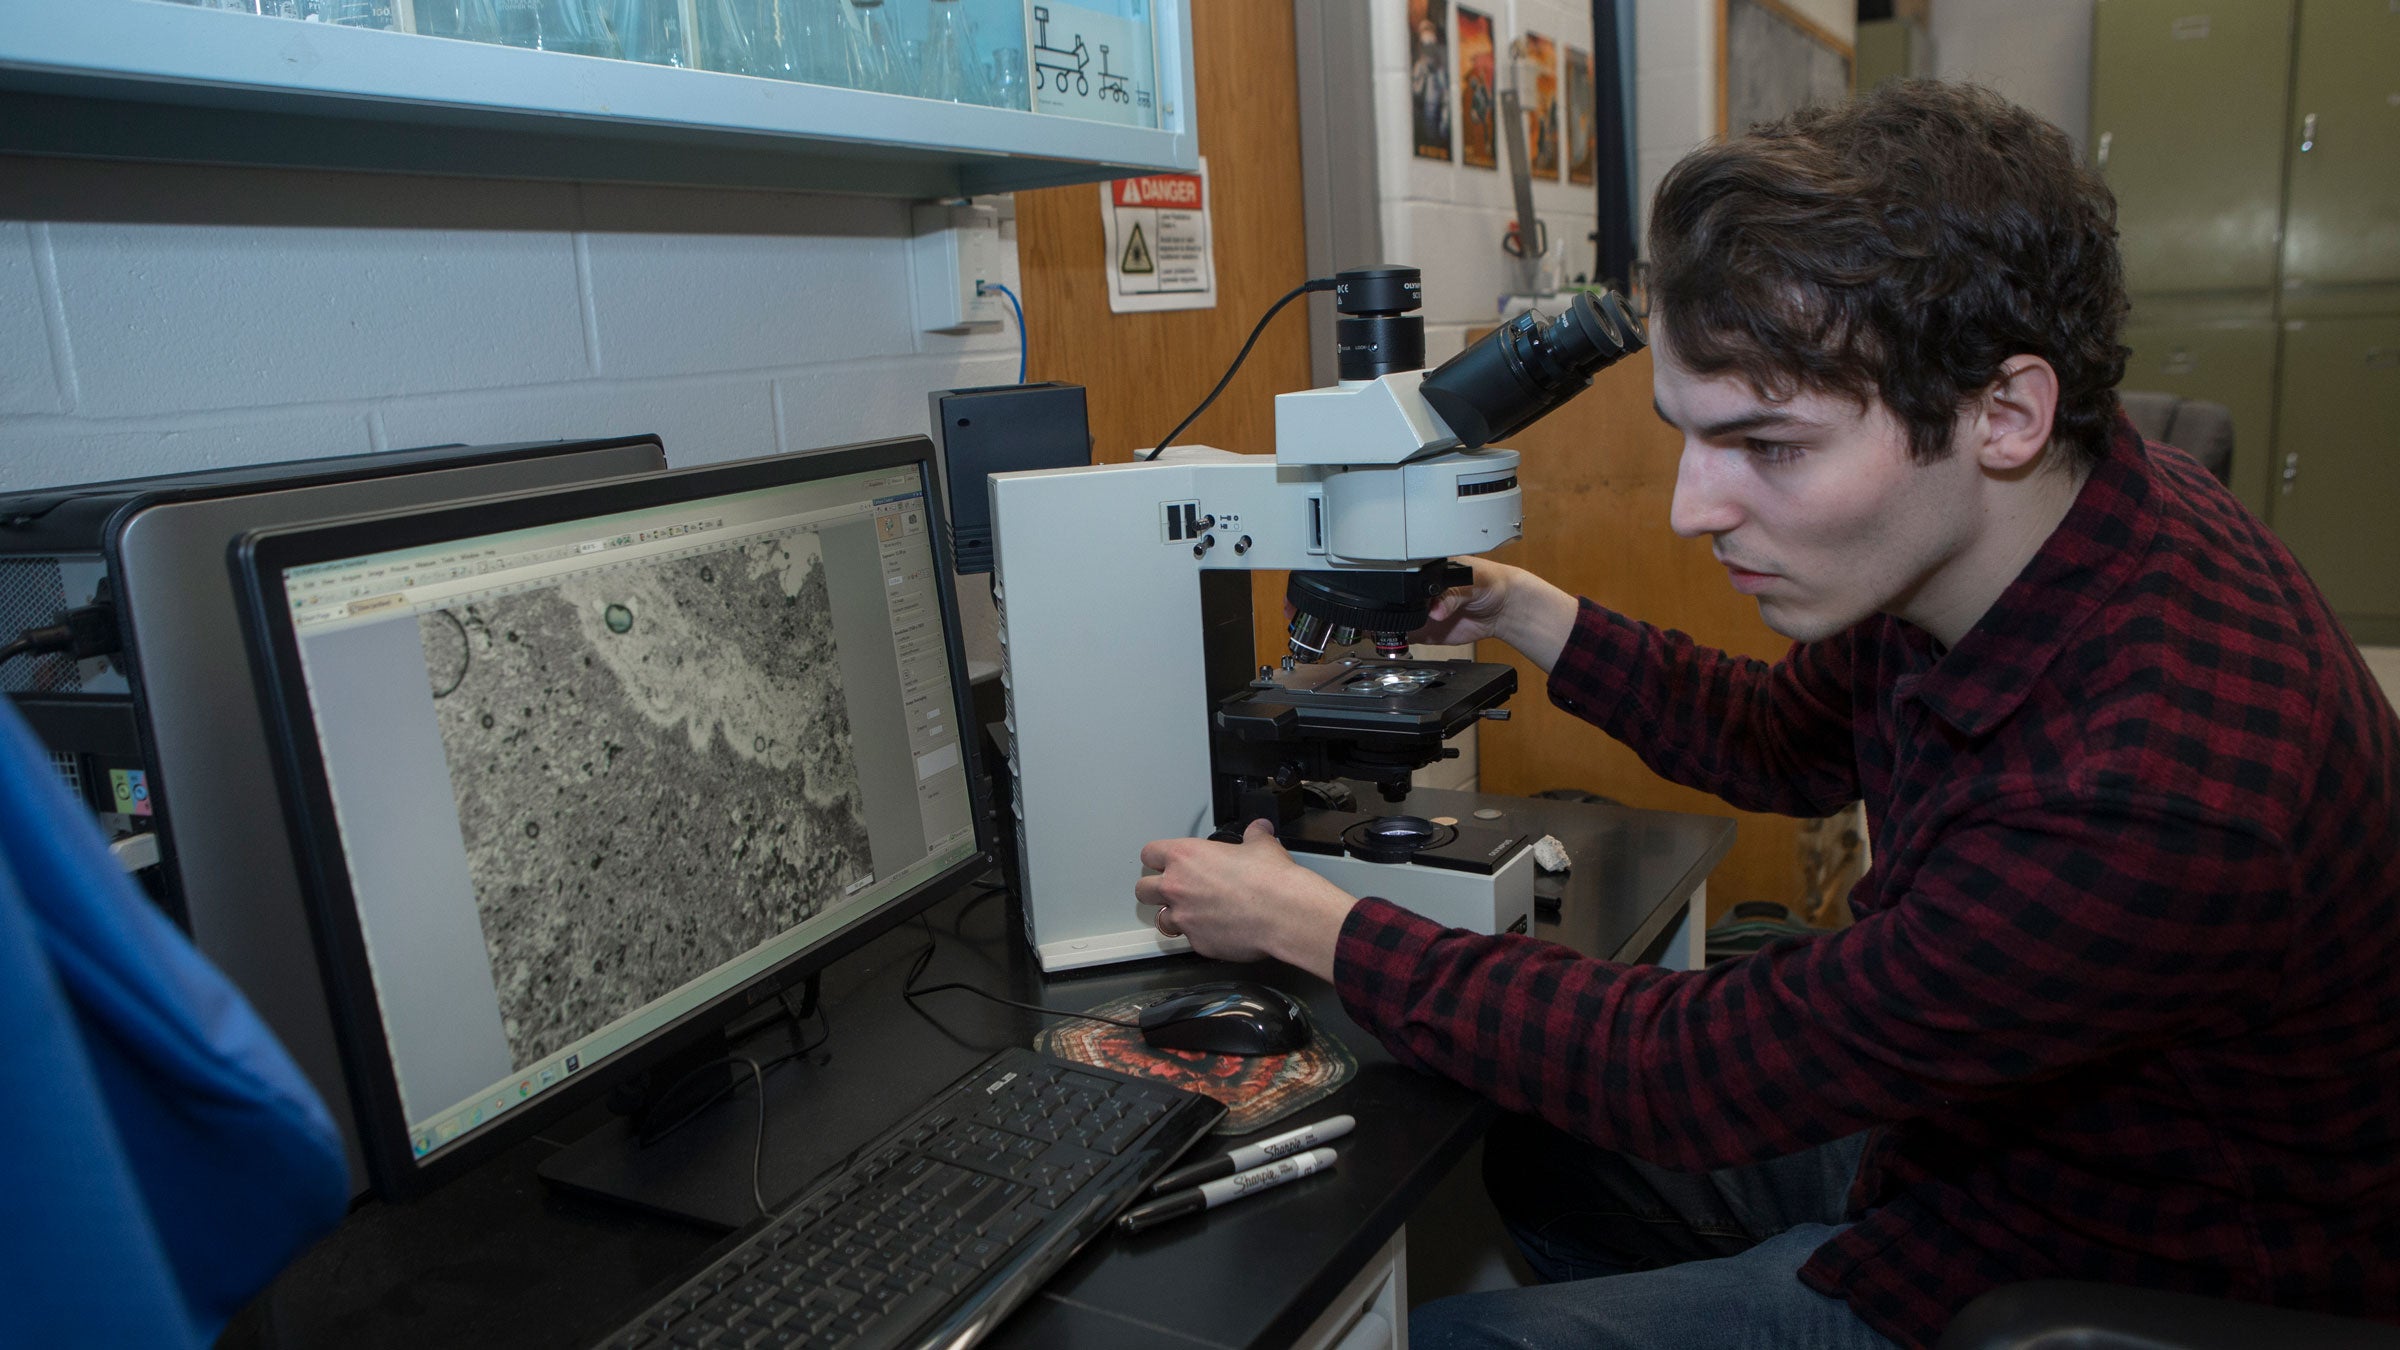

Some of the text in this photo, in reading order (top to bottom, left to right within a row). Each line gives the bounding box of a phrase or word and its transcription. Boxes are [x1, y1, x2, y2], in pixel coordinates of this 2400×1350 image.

[1141, 178, 1197, 202] DANGER
[985, 1071, 1018, 1095] ASUS
[1264, 1137, 1301, 1159] Sharpie
[1233, 1168, 1277, 1195] Sharpie
